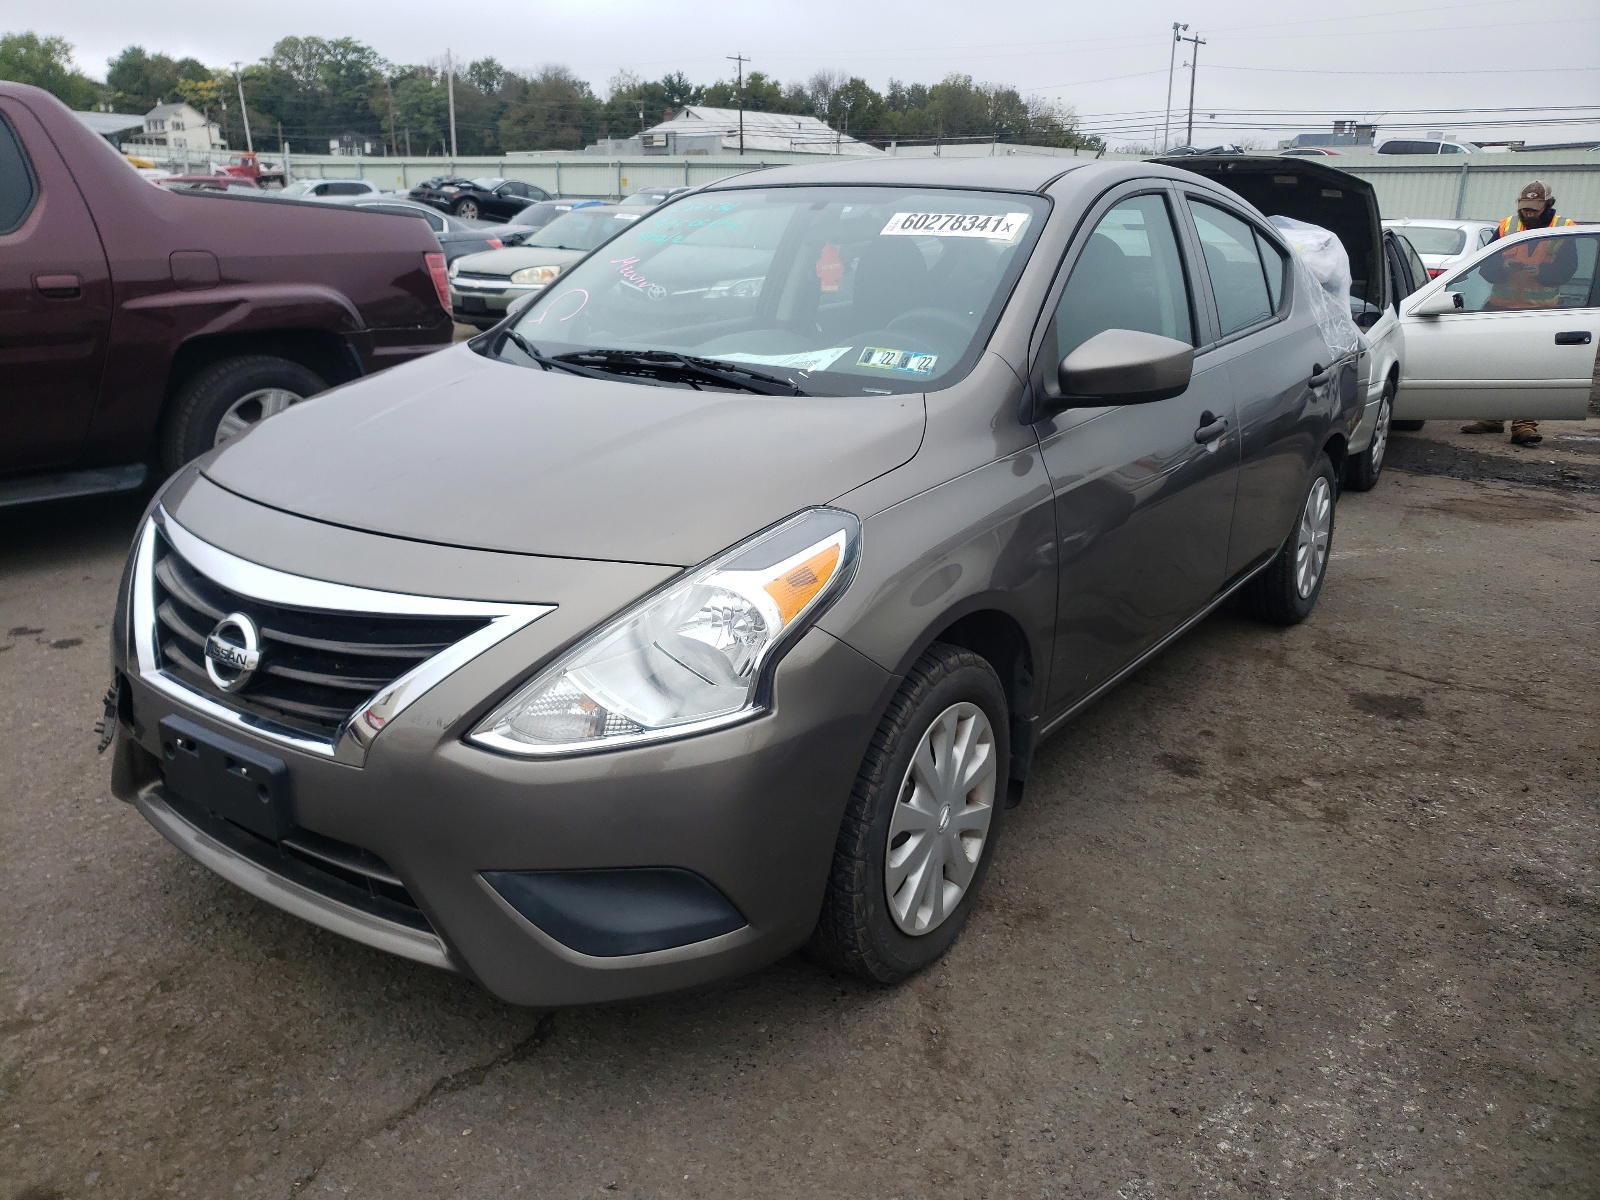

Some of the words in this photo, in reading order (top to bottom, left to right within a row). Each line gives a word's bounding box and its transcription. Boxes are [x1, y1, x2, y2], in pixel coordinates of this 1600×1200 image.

[880, 351, 896, 366] 22
[917, 356, 933, 371] 22
[207, 639, 248, 666] SSAN
